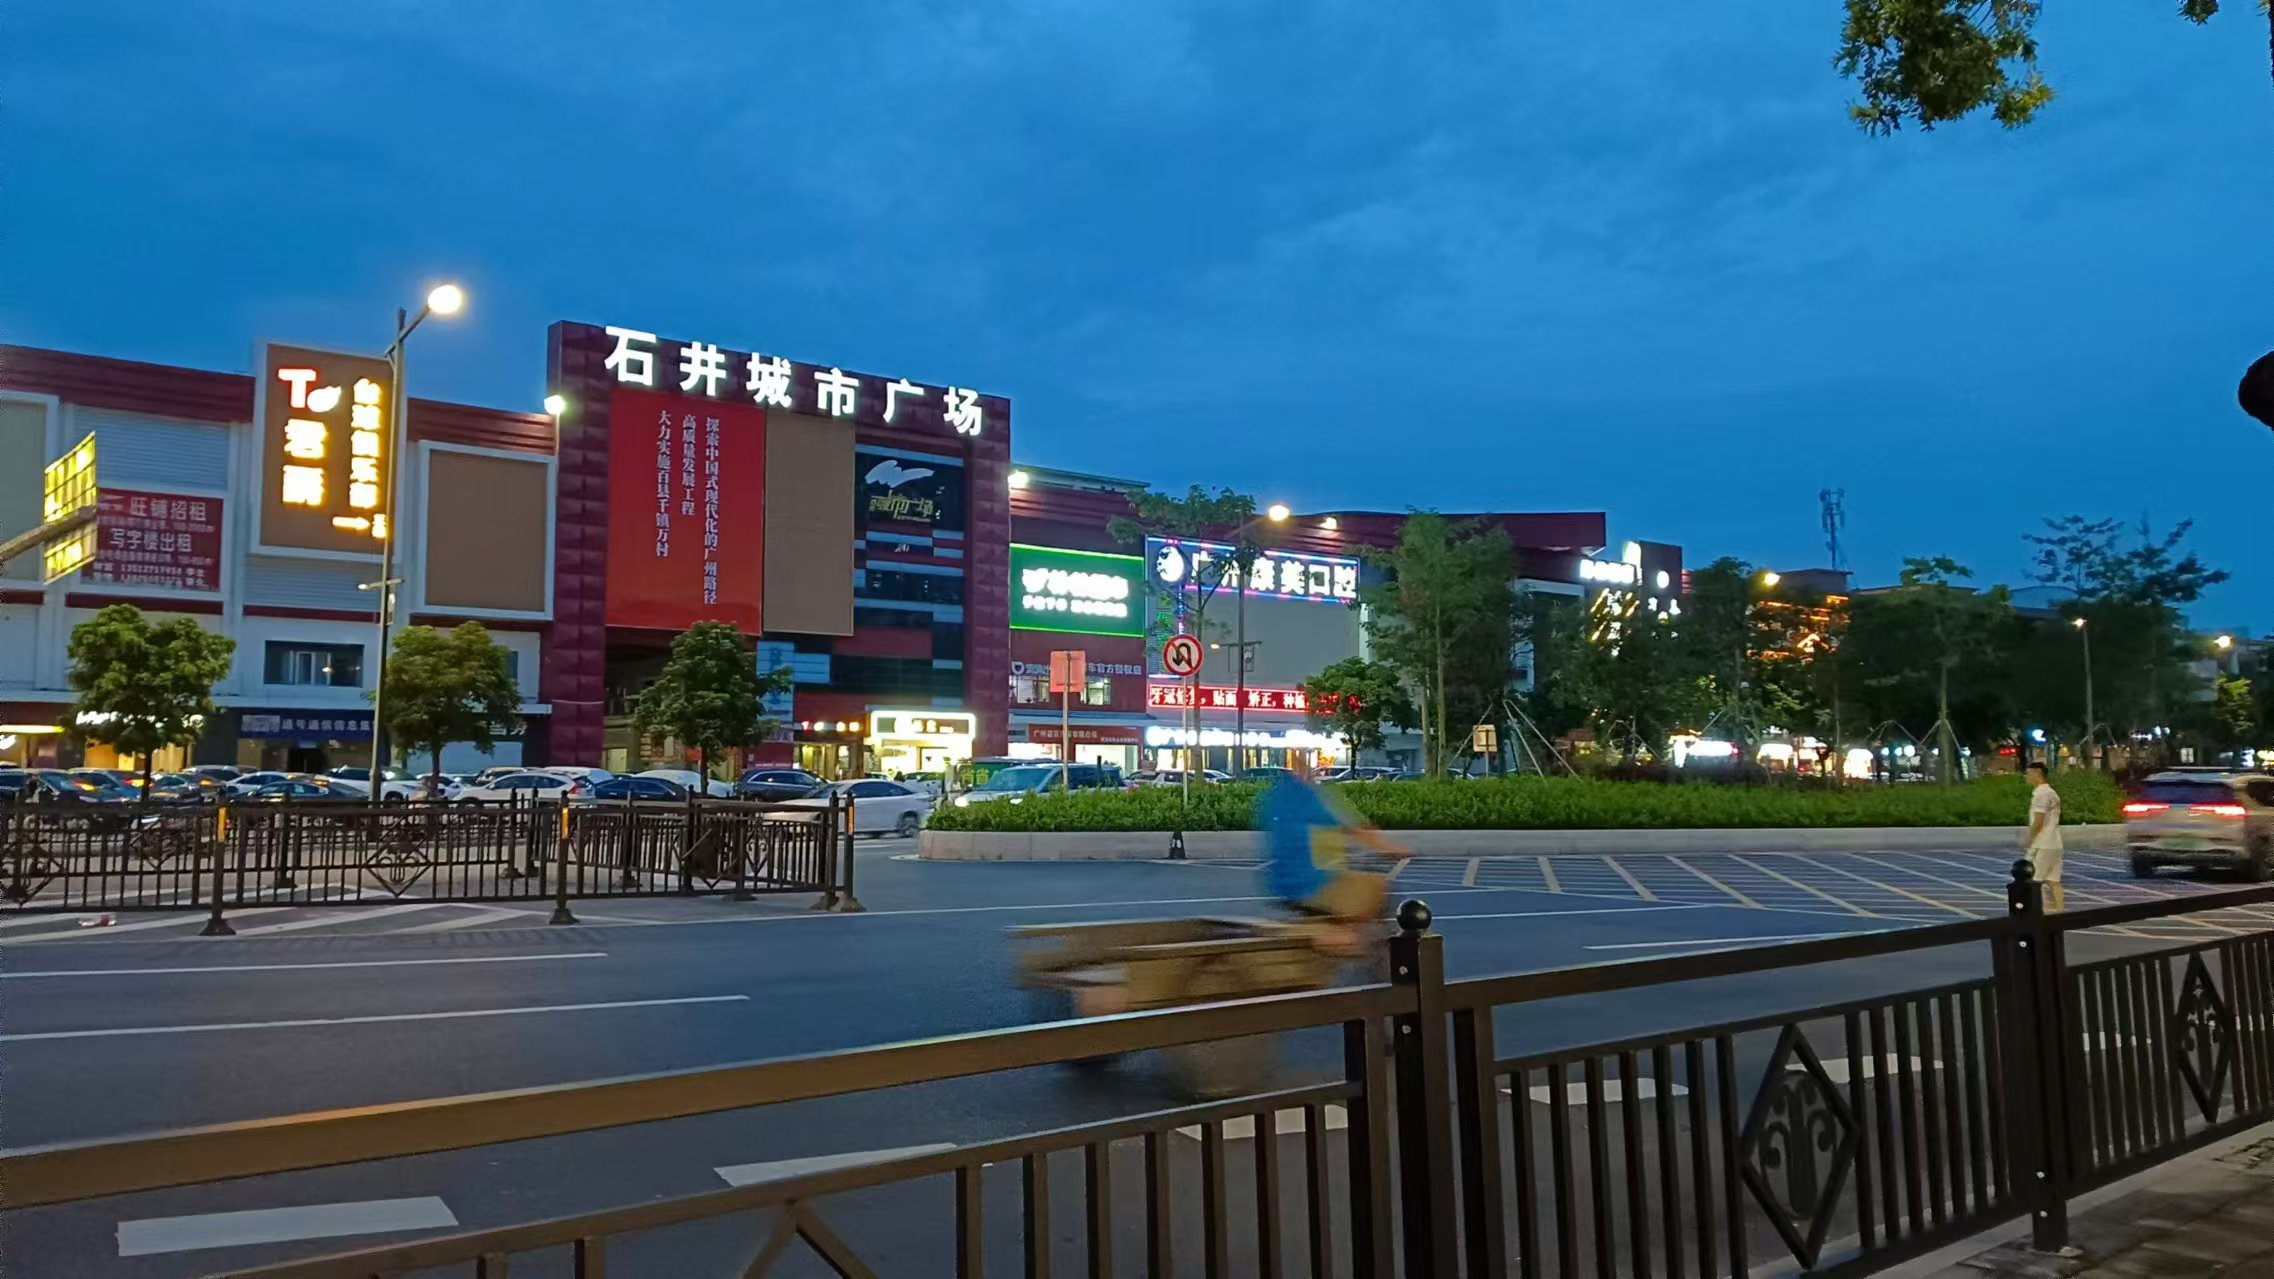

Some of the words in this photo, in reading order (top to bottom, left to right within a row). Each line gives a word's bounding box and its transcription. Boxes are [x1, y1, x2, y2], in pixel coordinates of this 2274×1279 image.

[604, 325, 984, 436] 石井城市广场
[129, 496, 207, 521] 旺铺招租
[655, 409, 672, 557] 大力实施百县千镇万村
[680, 414, 697, 517] 高质量发展工程
[703, 417, 720, 605] 探索中国式现代化的广州路径
[109, 527, 192, 553] 写字楼出租
